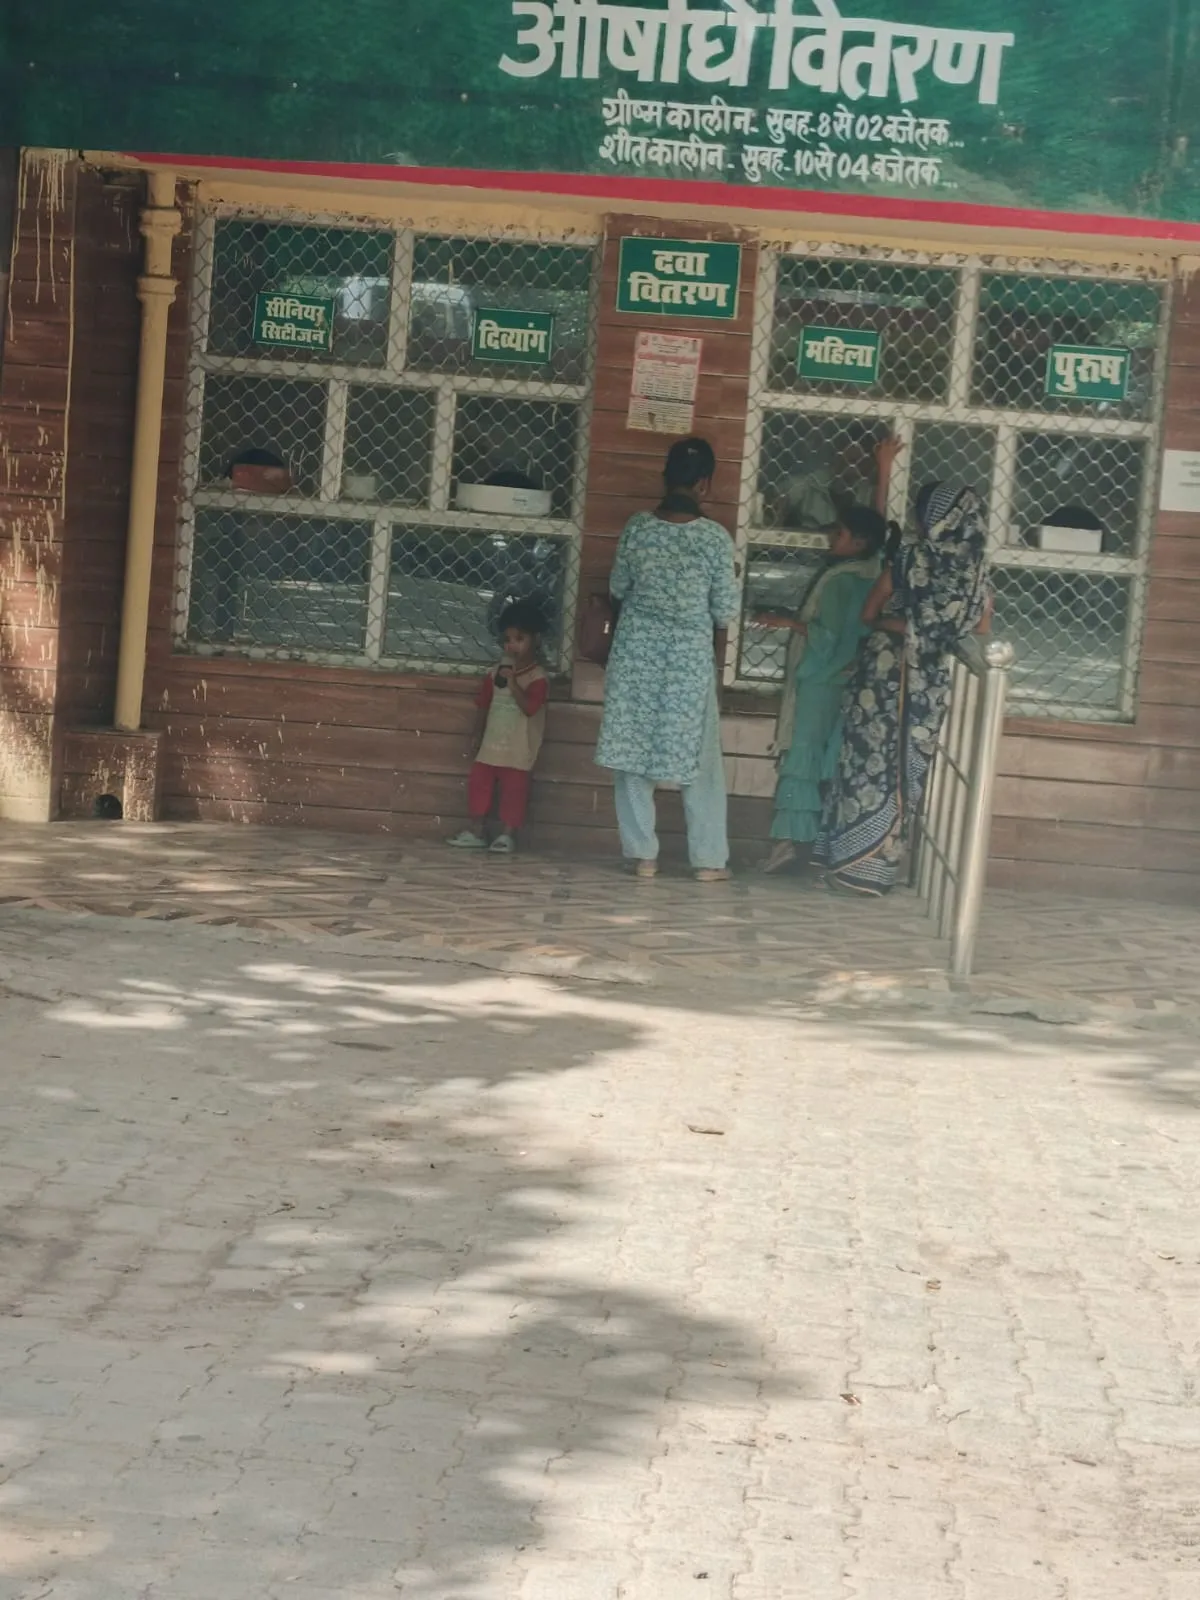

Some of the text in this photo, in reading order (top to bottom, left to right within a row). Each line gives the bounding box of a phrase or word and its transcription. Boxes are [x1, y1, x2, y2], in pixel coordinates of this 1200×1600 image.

[768, 0, 1015, 104] वितरण
[652, 250, 710, 277] दवा
[627, 271, 731, 307] वितरण
[261, 320, 326, 345] सिटीजन
[478, 319, 548, 353] दिव्यांग
[804, 335, 876, 367] महिला
[1053, 352, 1125, 393] पुरुष
